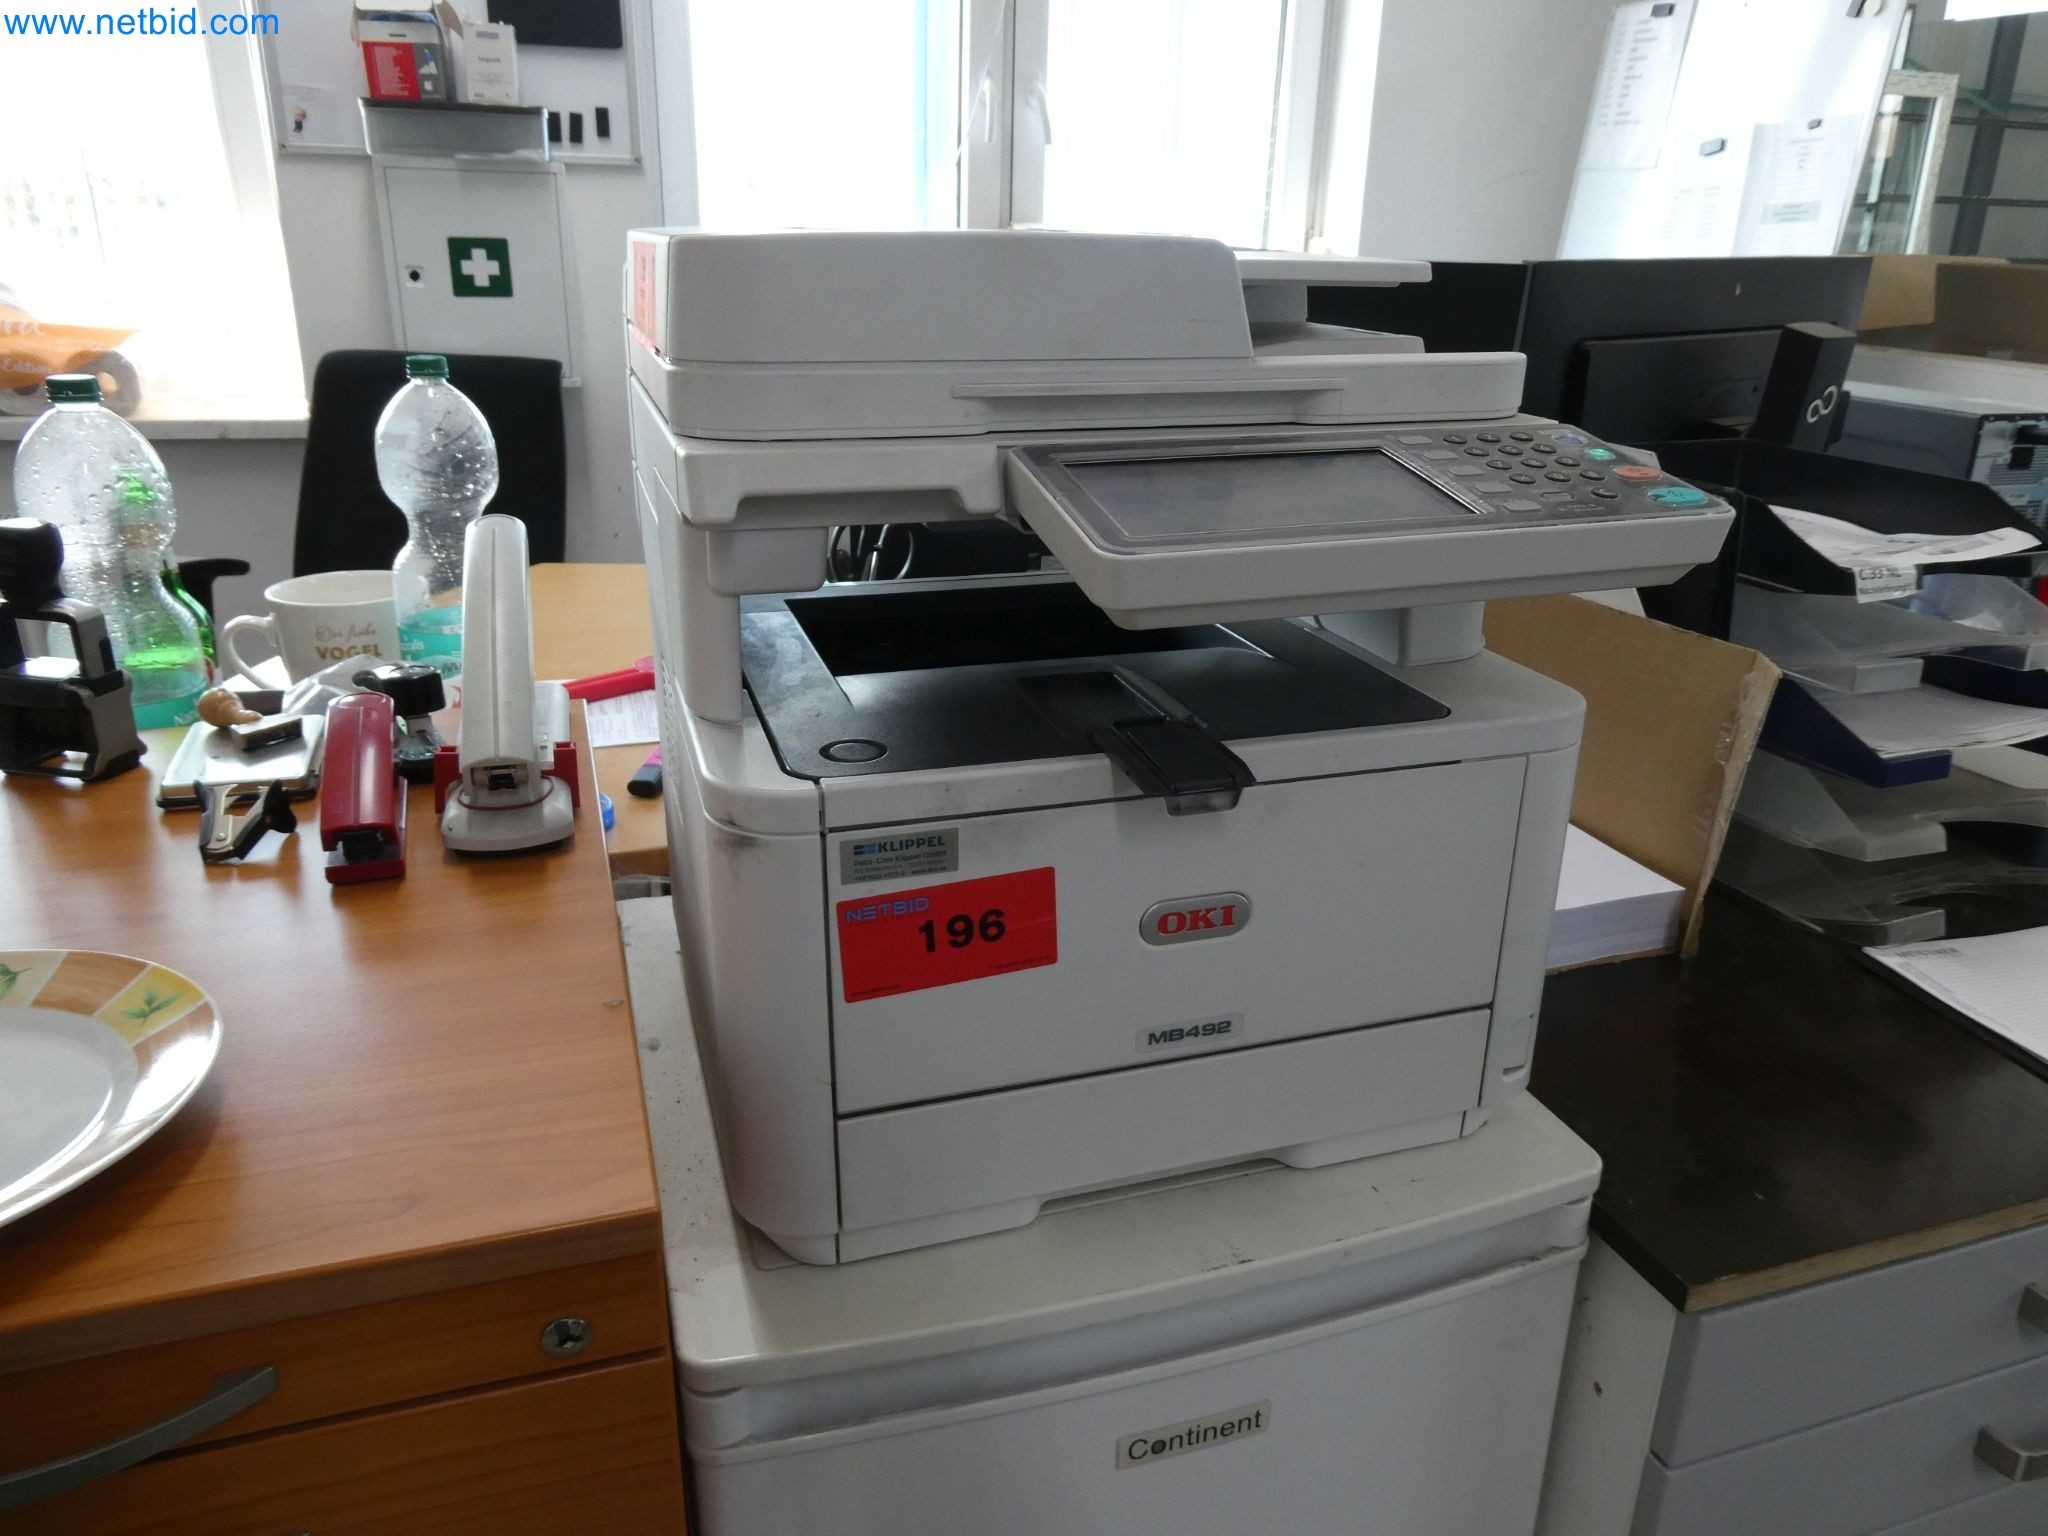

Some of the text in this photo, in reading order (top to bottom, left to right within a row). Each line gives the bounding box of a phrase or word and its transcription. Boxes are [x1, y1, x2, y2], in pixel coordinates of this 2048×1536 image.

[877, 836, 947, 853] KLIPPEL
[922, 850, 947, 859] GmbH
[845, 897, 931, 923] NETBID
[1157, 905, 1236, 936] OKI
[918, 908, 1006, 953] 196
[1148, 1020, 1232, 1046] MB492
[1128, 1410, 1262, 1460] Continent
